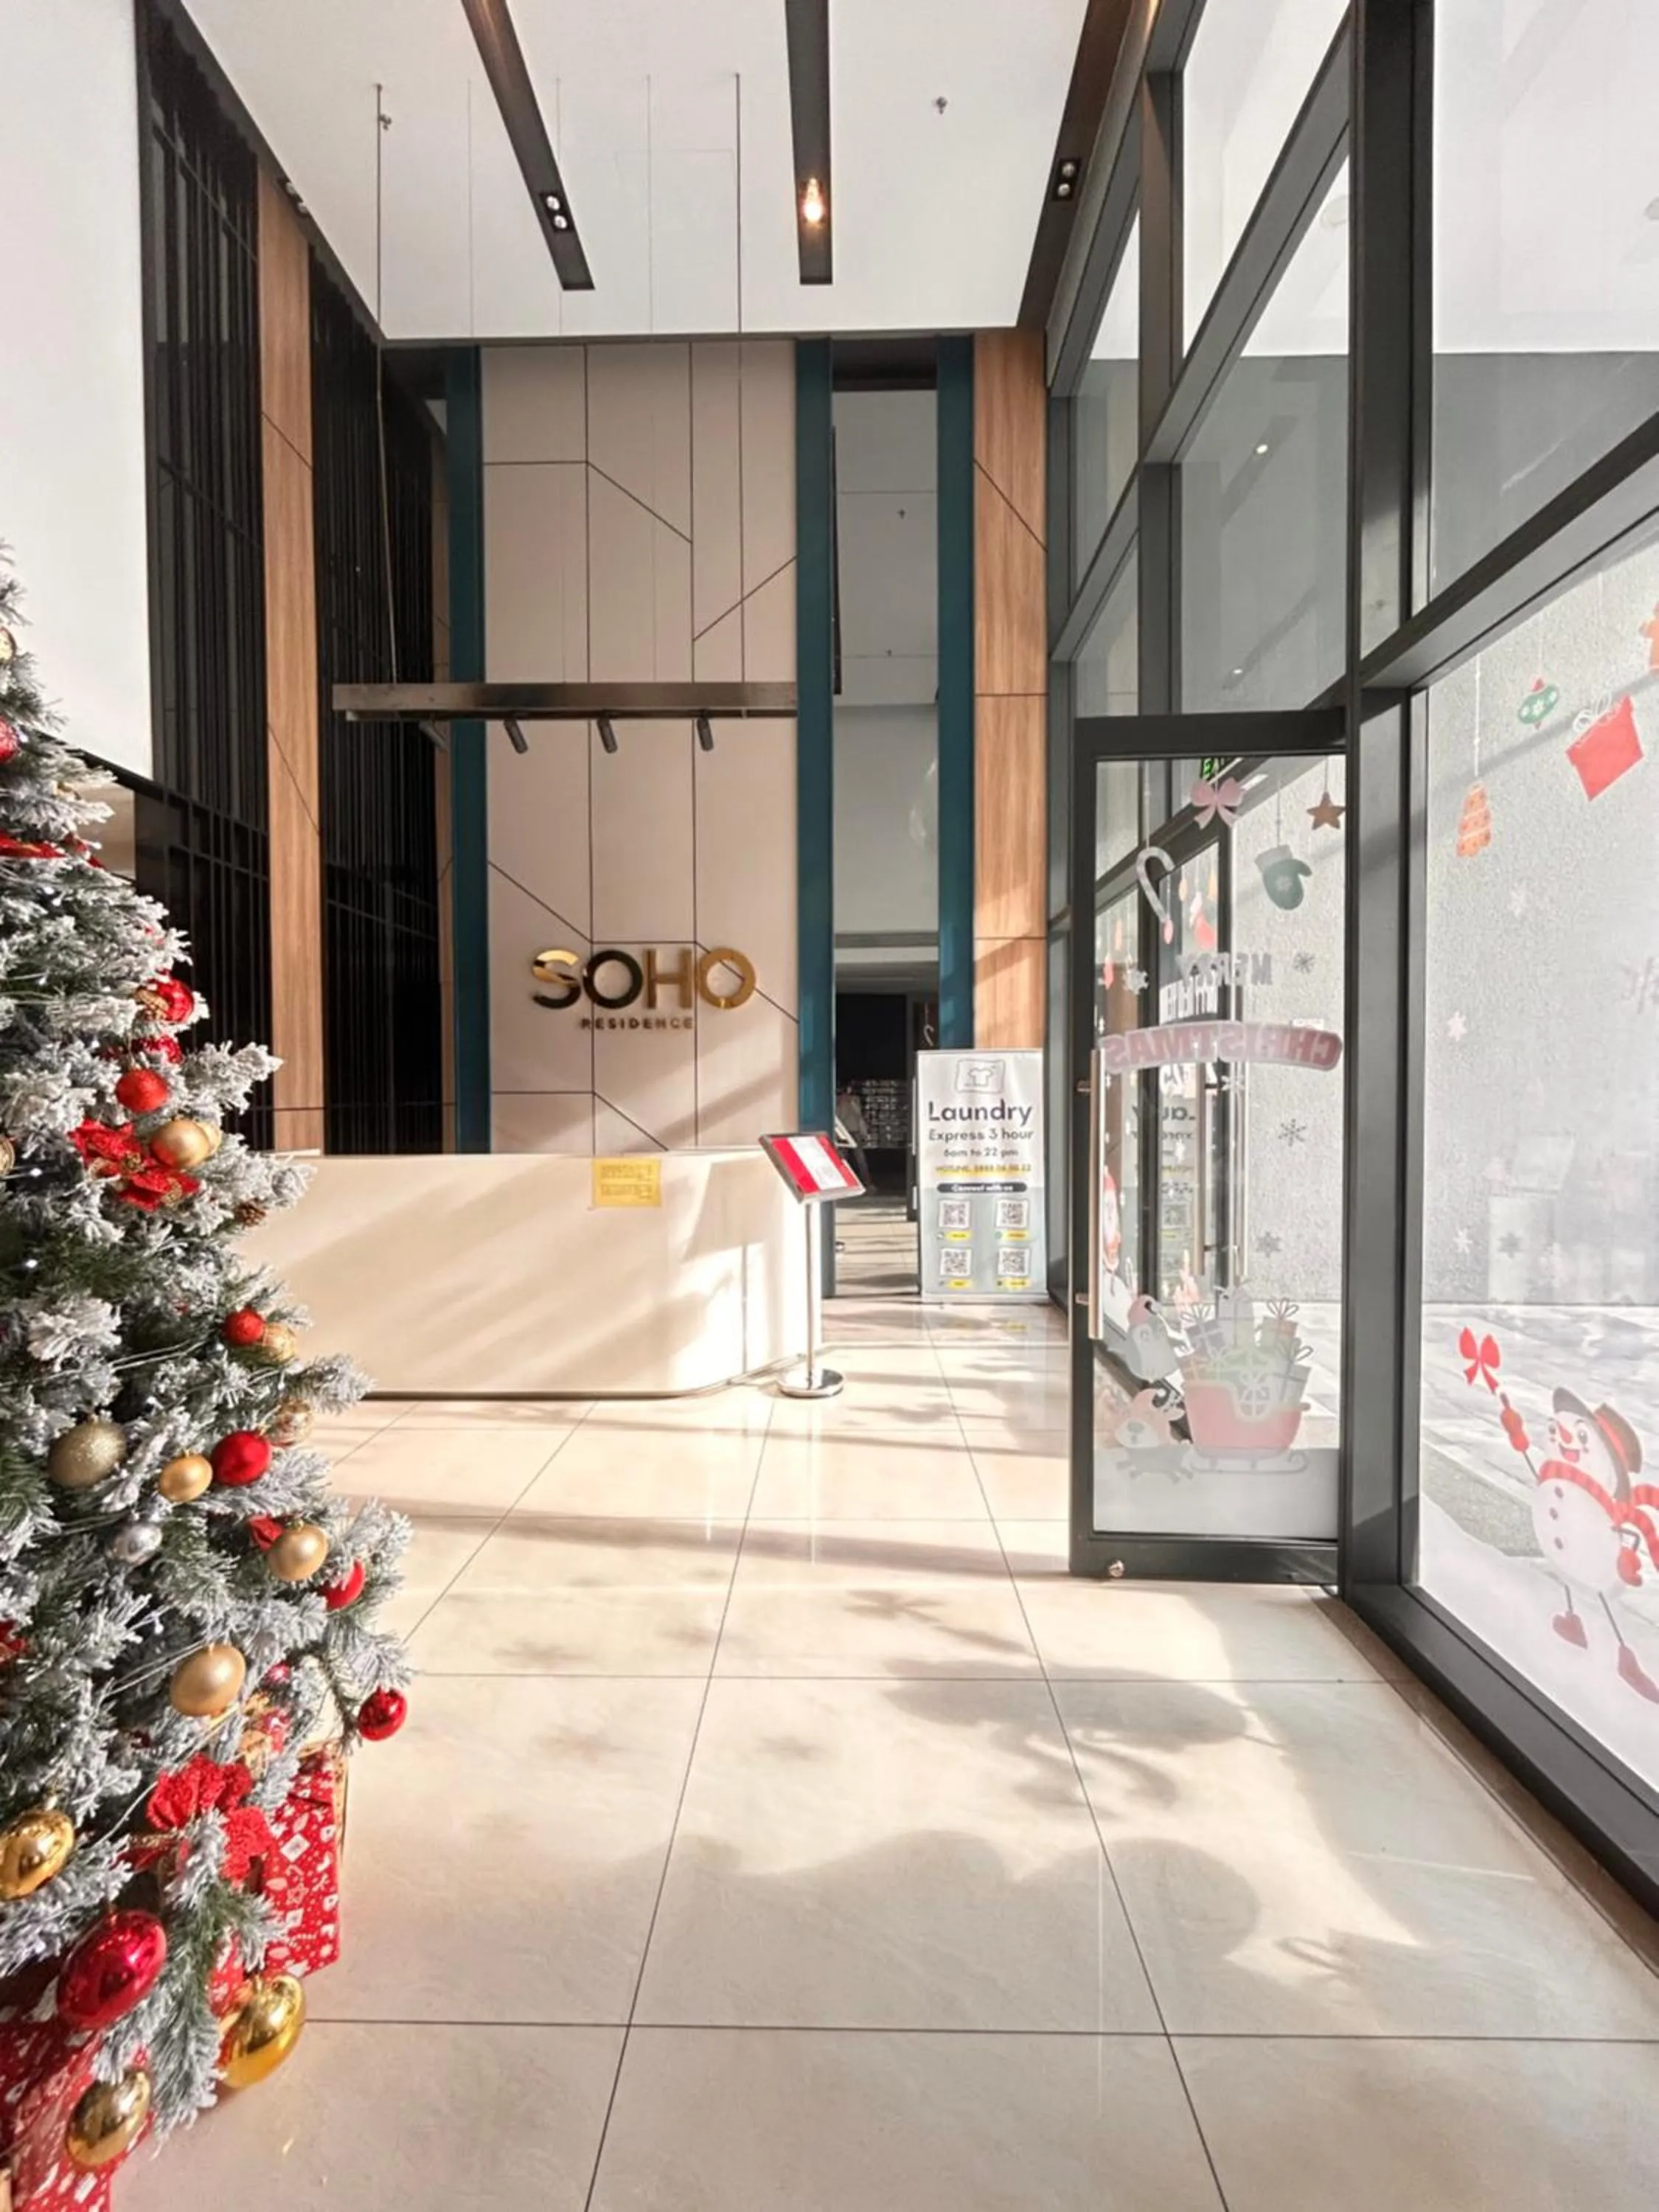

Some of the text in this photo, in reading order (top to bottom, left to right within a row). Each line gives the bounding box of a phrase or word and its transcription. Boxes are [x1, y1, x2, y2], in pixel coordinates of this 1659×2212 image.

[532, 948, 756, 1009] SOHO
[580, 1018, 694, 1030] RESIDENCE
[928, 1099, 1032, 1127] Laundry
[928, 1127, 1034, 1142] Express 3 hour
[970, 1149, 981, 1157] to
[1001, 1150, 1019, 1158] pm
